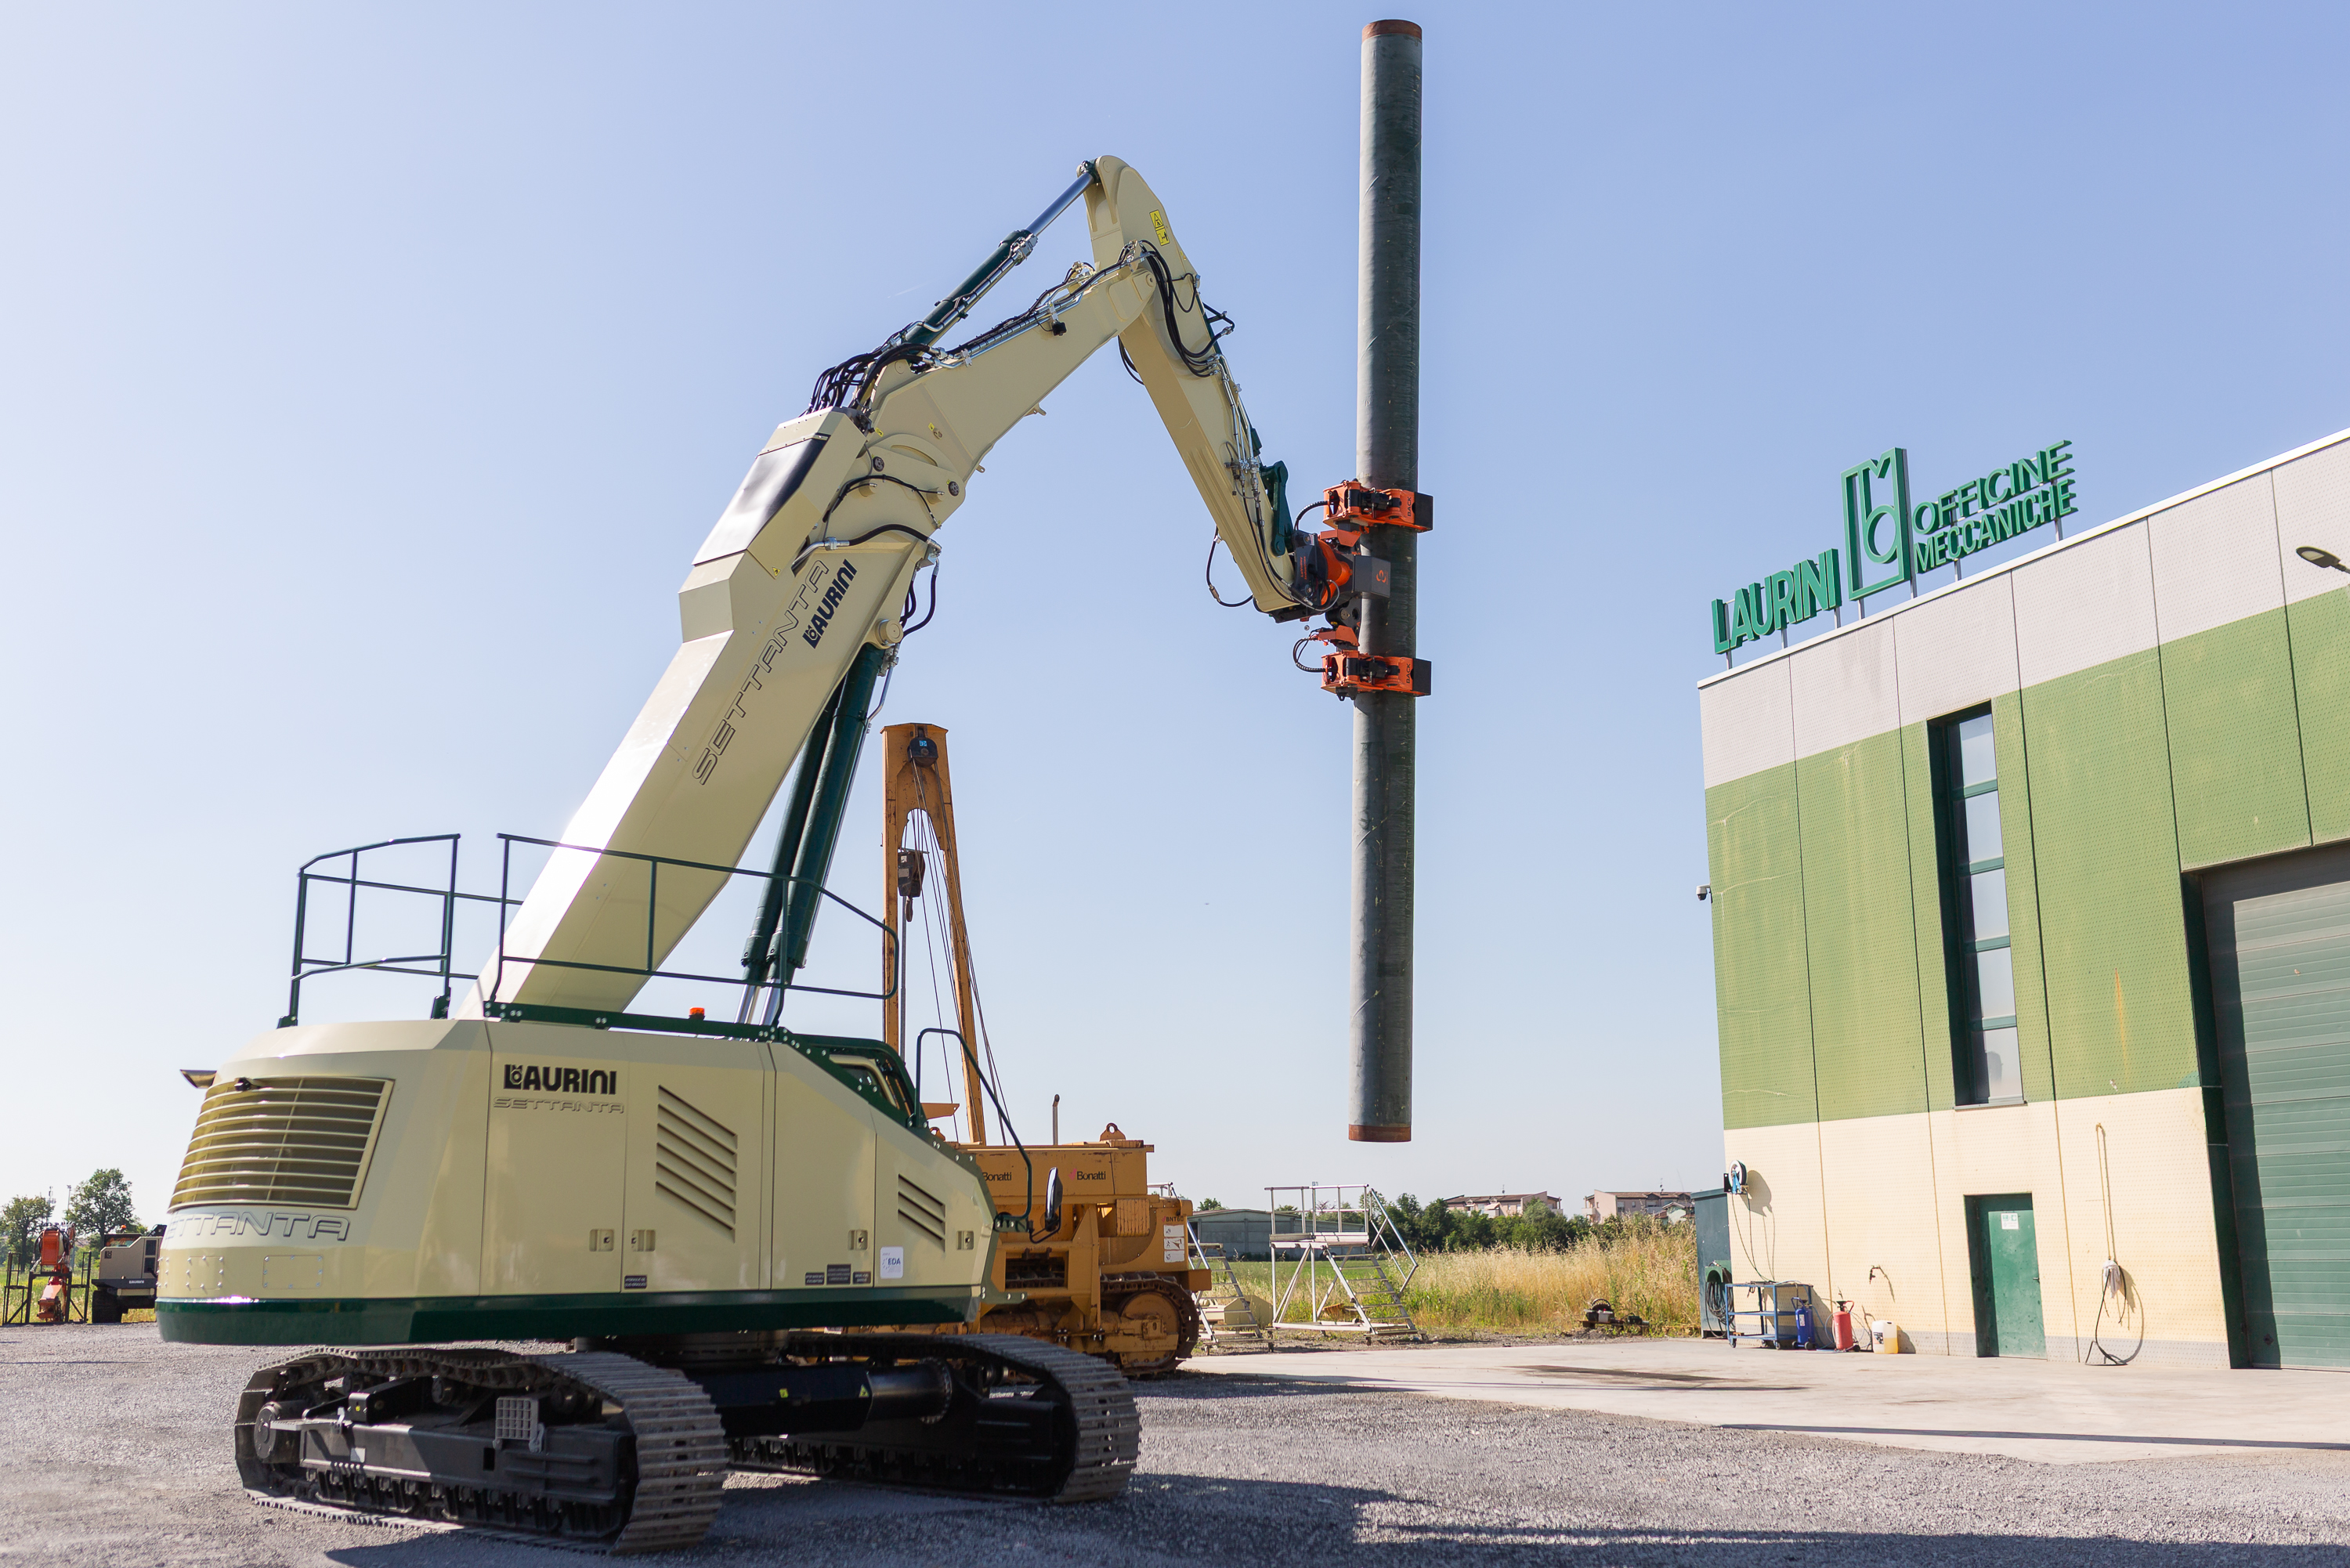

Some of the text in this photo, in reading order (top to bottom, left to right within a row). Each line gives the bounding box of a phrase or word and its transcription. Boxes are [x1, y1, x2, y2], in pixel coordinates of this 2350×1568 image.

[1912, 439, 2073, 535] OFFICINE
[1914, 479, 2078, 574] MECCANICHE
[801, 558, 858, 649] LAURINI
[1712, 548, 1842, 654] LAURINI
[692, 559, 830, 786] SETTANTA
[494, 1097, 624, 1114] SETTANTA
[504, 1064, 617, 1095] LAURINI
[1076, 1171, 1106, 1180] Bonatti
[165, 1211, 350, 1241] ETTANTA
